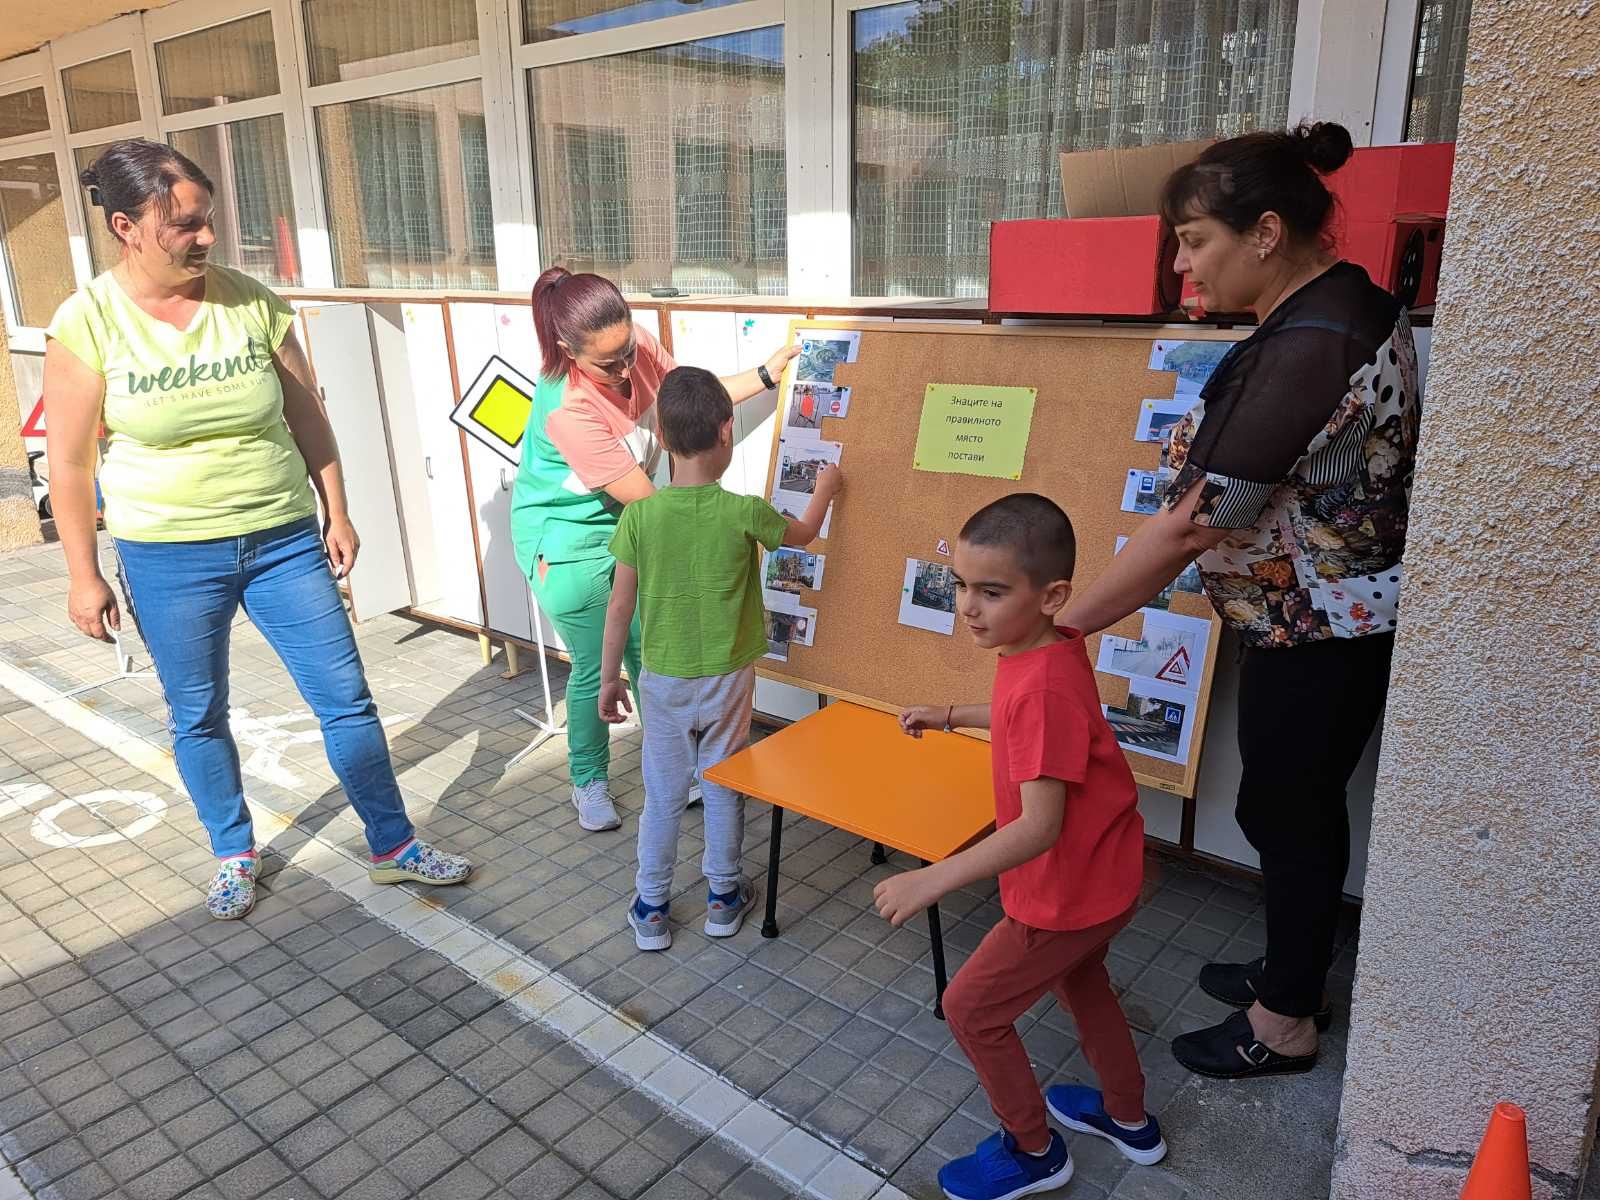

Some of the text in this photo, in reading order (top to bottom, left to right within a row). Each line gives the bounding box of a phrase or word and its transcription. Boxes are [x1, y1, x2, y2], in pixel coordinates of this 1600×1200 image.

[128, 336, 262, 395] weekend
[181, 389, 211, 400] HAVE
[216, 382, 247, 394] SOME
[951, 395, 1003, 408] Знаците на
[945, 415, 1001, 426] правилното
[955, 434, 984, 444] място
[948, 451, 985, 462] постави
